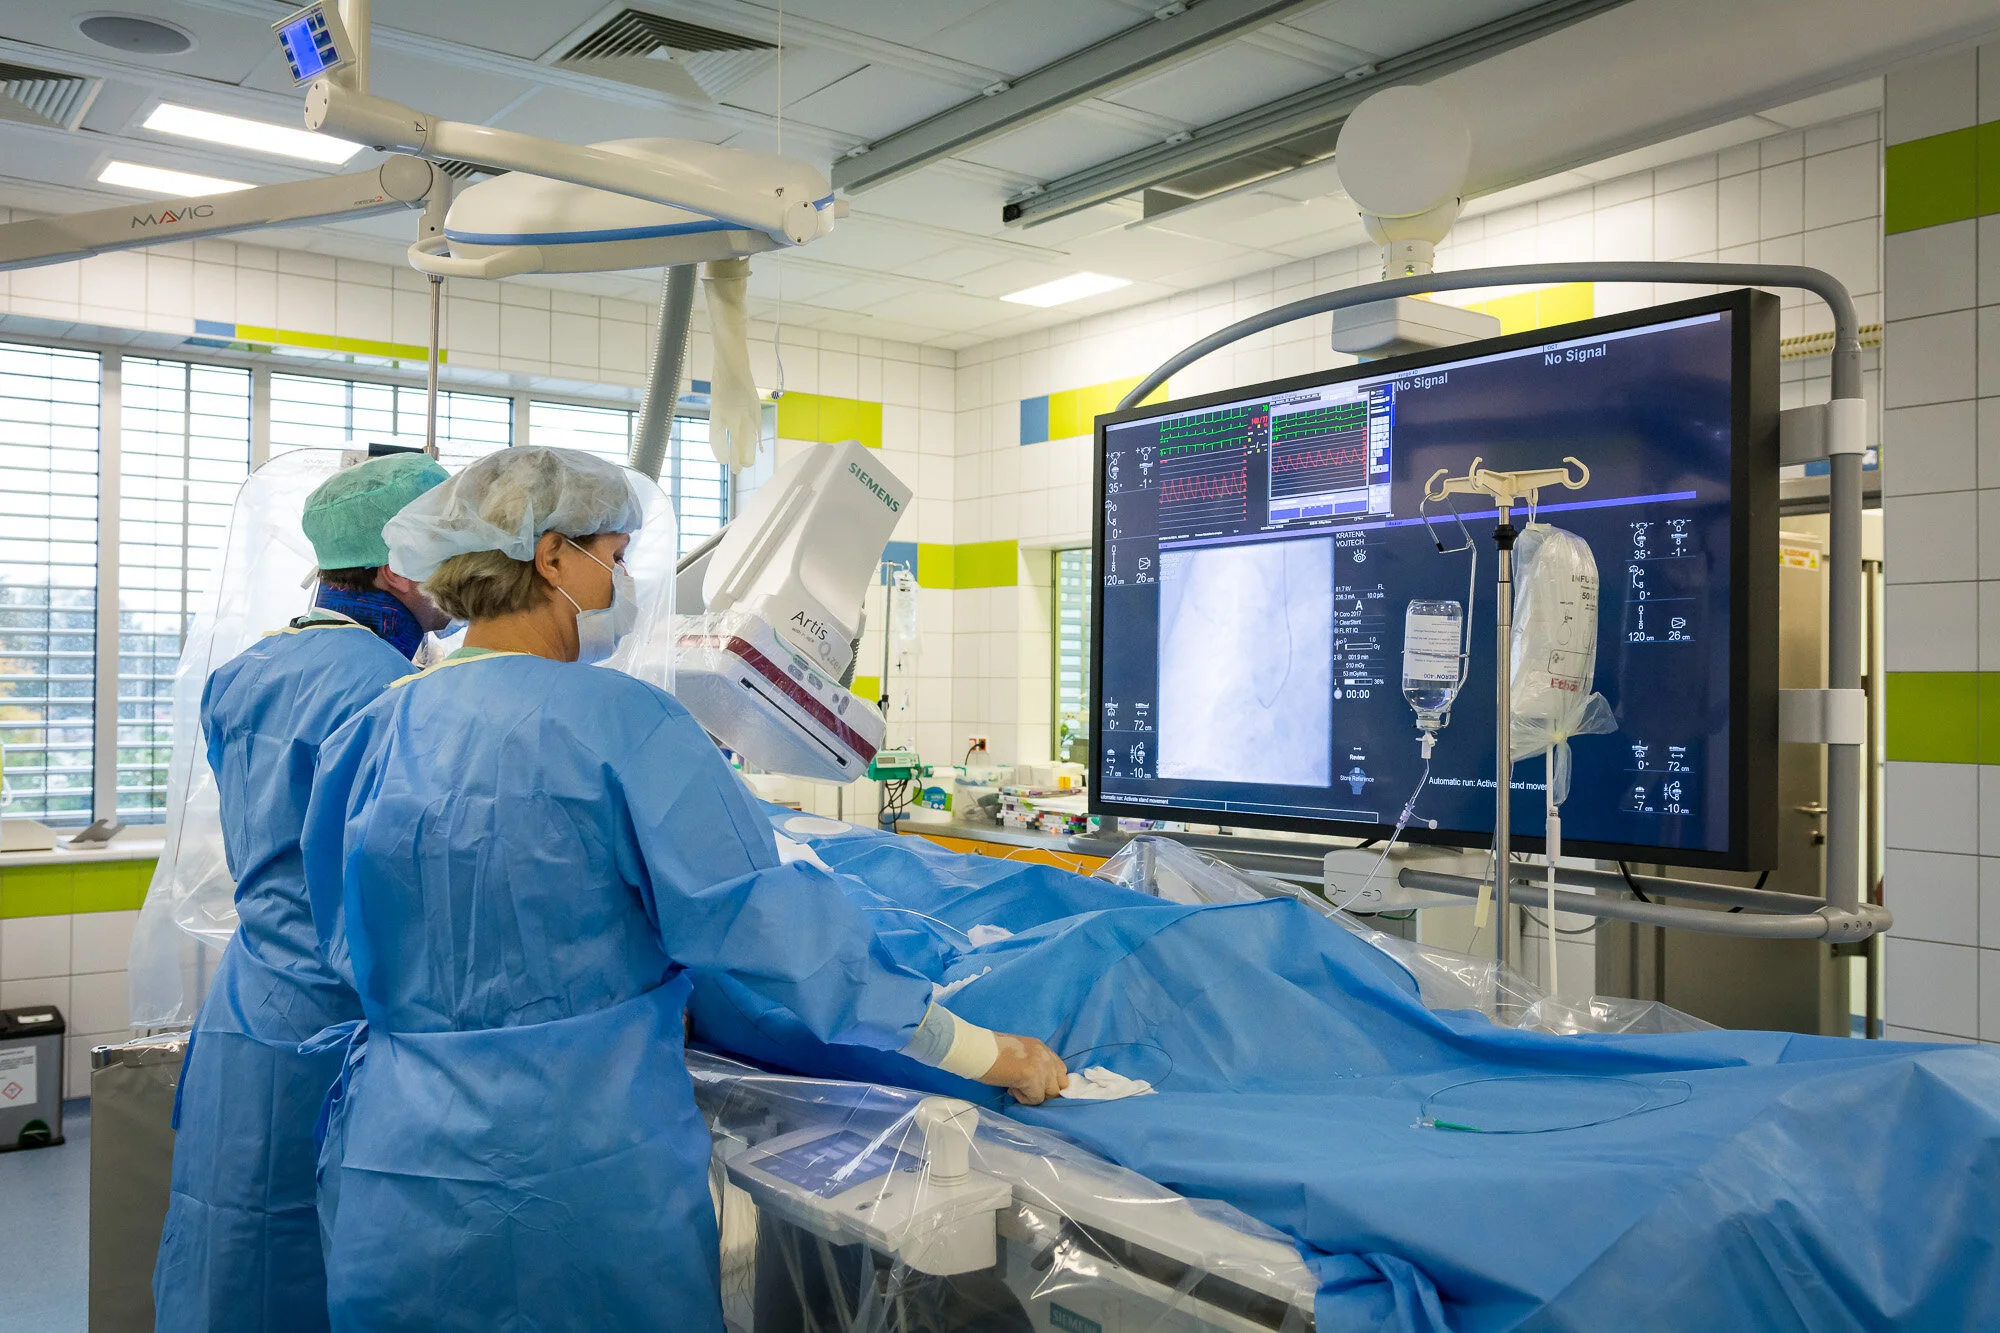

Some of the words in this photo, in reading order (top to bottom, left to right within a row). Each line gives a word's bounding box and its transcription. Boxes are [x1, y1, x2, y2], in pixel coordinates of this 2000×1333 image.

[131, 204, 214, 228] MAVIG
[1545, 353, 1562, 366] No
[1566, 344, 1606, 362] Signal
[1396, 380, 1410, 392] No
[1414, 372, 1448, 389] Signal
[848, 462, 900, 512] SIEMENS
[1335, 539, 1364, 547] VOJTECH
[1104, 575, 1117, 585] 120
[1136, 573, 1146, 584] 26
[1355, 600, 1363, 610] A
[790, 611, 828, 640] Artis
[1628, 632, 1645, 641] 120
[1668, 631, 1680, 640] 26
[1346, 690, 1370, 699] 00:00
[1134, 720, 1144, 731] 72
[1667, 761, 1680, 772] 72
[1130, 767, 1144, 779] -10
[1352, 775, 1374, 783] Reference
[1428, 776, 1461, 786] Automatic
[1462, 779, 1475, 787] run:
[1477, 779, 1497, 788] Activa
[1509, 780, 1524, 789] tand
[1663, 804, 1680, 813] -10
